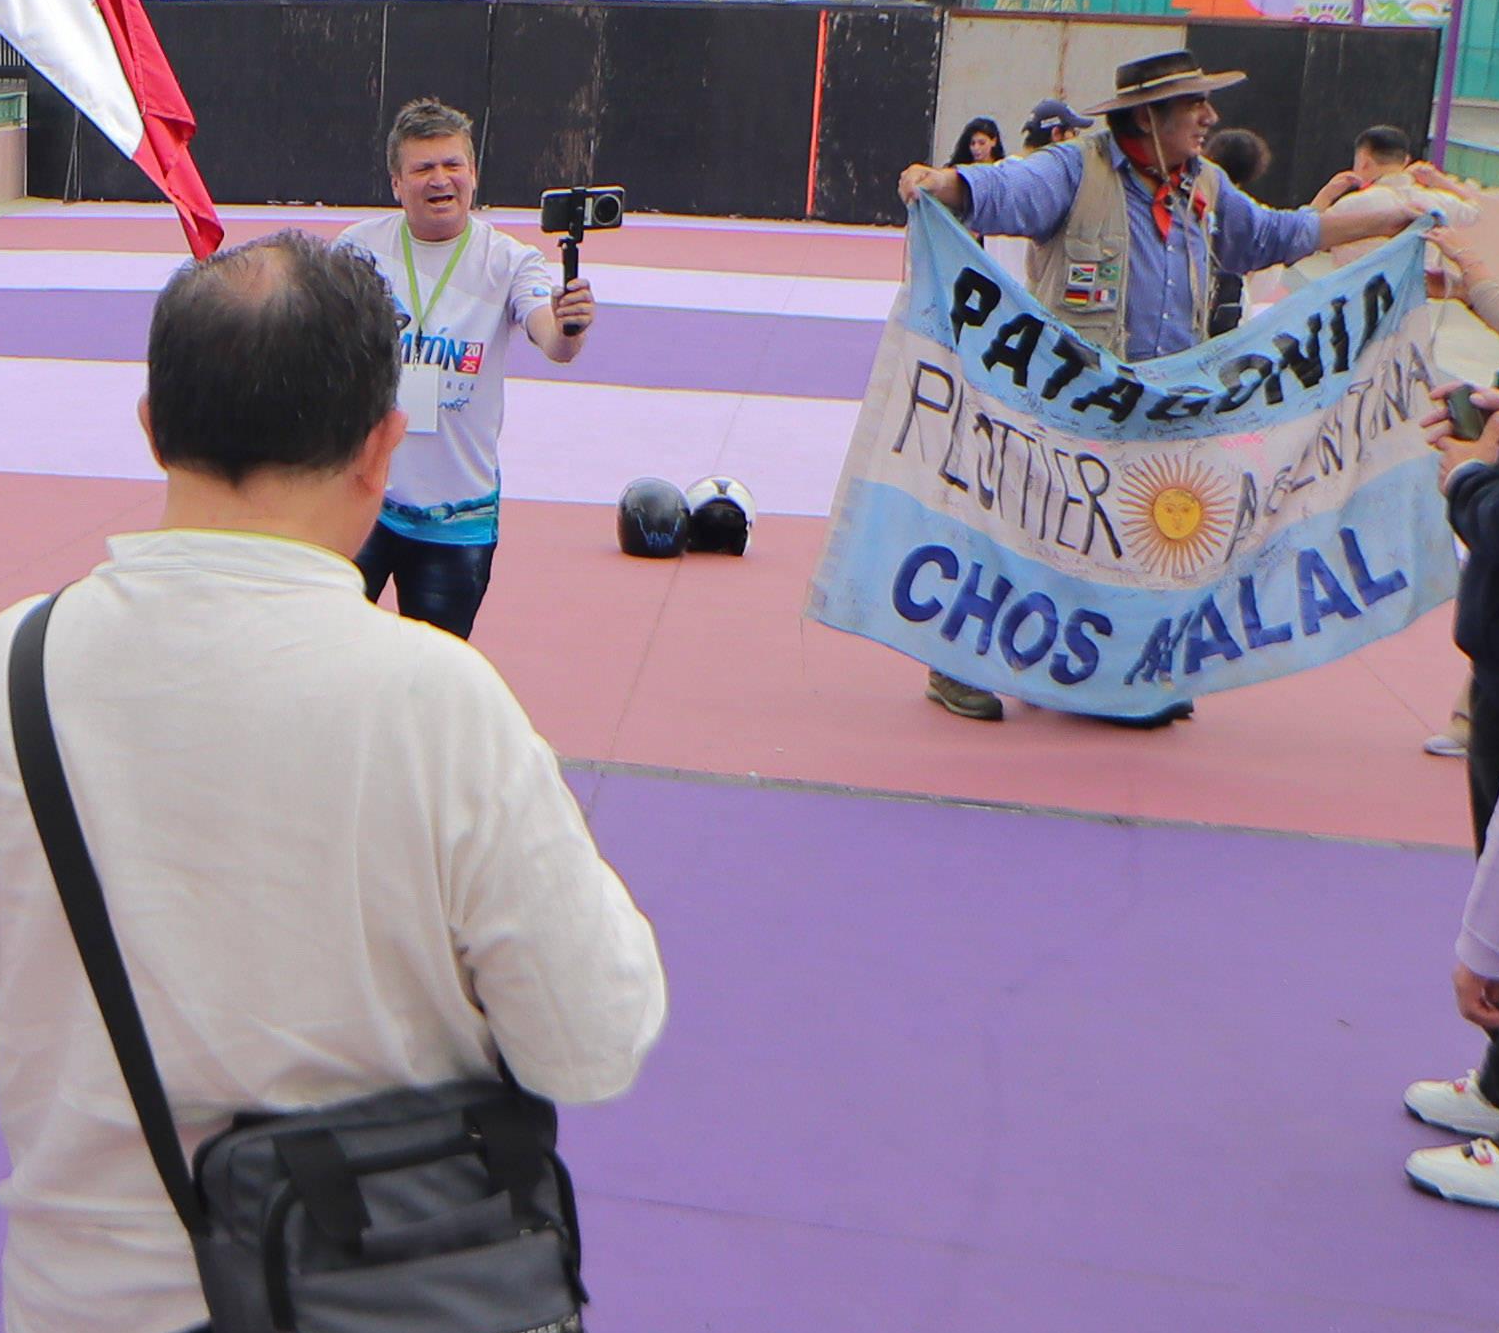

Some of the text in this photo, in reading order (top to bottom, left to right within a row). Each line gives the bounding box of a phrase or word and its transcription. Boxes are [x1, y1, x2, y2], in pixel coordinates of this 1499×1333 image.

[950, 266, 1395, 424] PATAGONIA
[889, 359, 1123, 560] PLOTTIER
[891, 526, 1408, 686] CHOS MALAL
